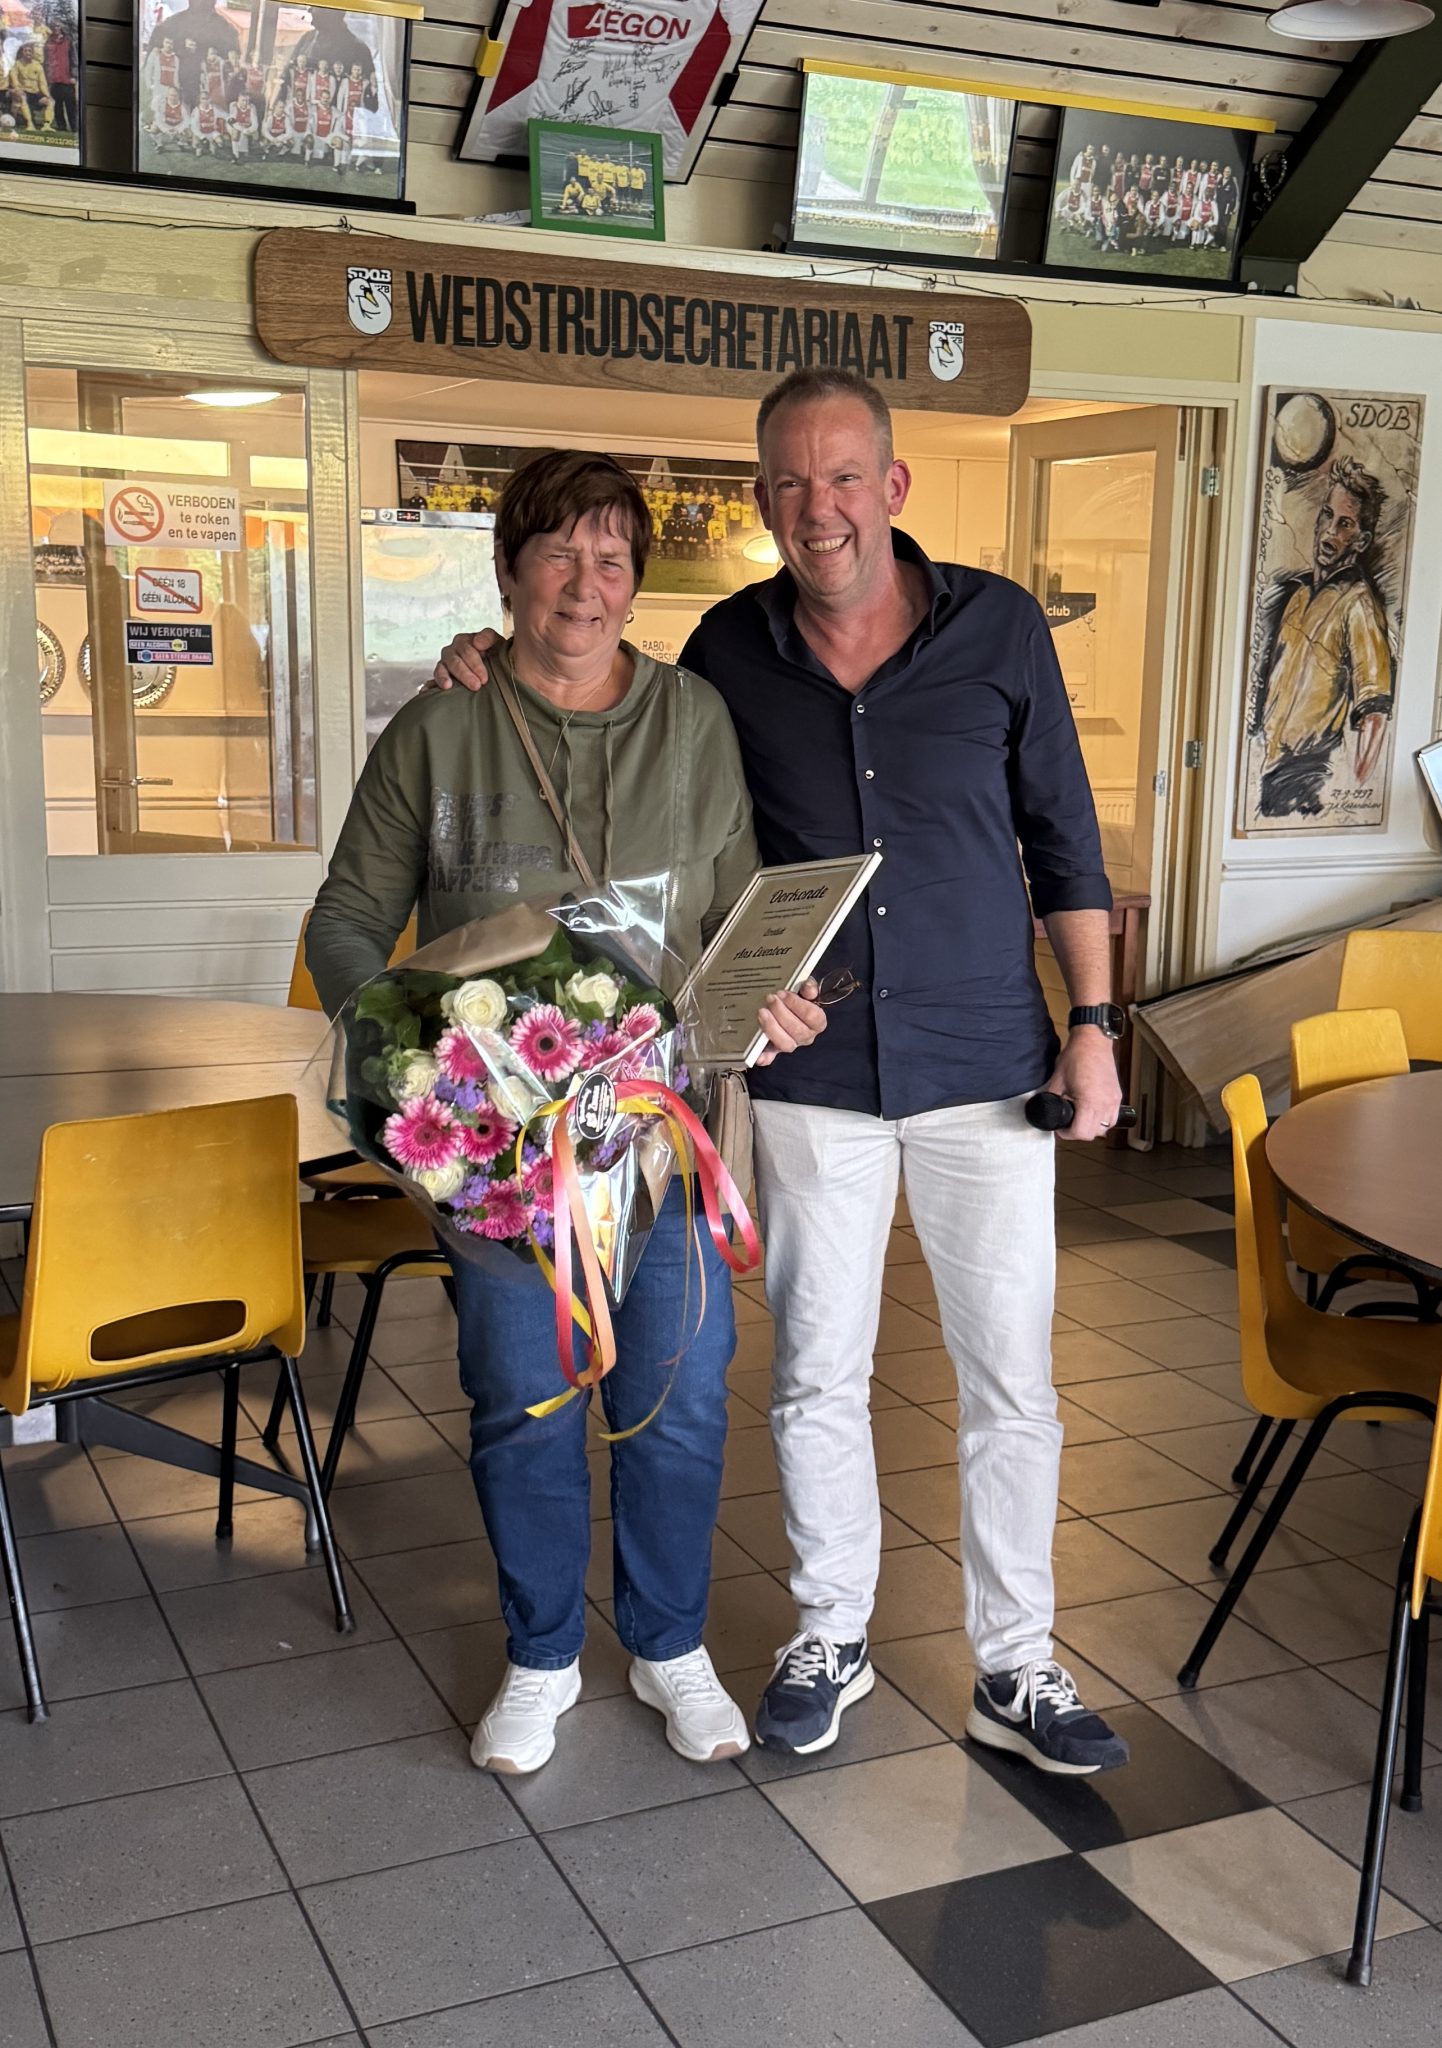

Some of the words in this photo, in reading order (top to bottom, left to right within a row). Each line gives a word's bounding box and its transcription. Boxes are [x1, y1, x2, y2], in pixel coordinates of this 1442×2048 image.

[585, 8, 691, 40] AEGON
[405, 270, 914, 380] WEDSTRIJDSECRETARIAAT
[1346, 403, 1411, 430] SDOB
[167, 494, 236, 509] VERBODEN
[180, 511, 191, 523] te
[195, 513, 230, 525] roken
[168, 528, 183, 538] en
[186, 528, 198, 539] te
[201, 530, 236, 542] vapen
[177, 579, 186, 588] 18
[1046, 605, 1070, 616] club
[129, 625, 149, 637] WIJ
[642, 640, 664, 652] RABO
